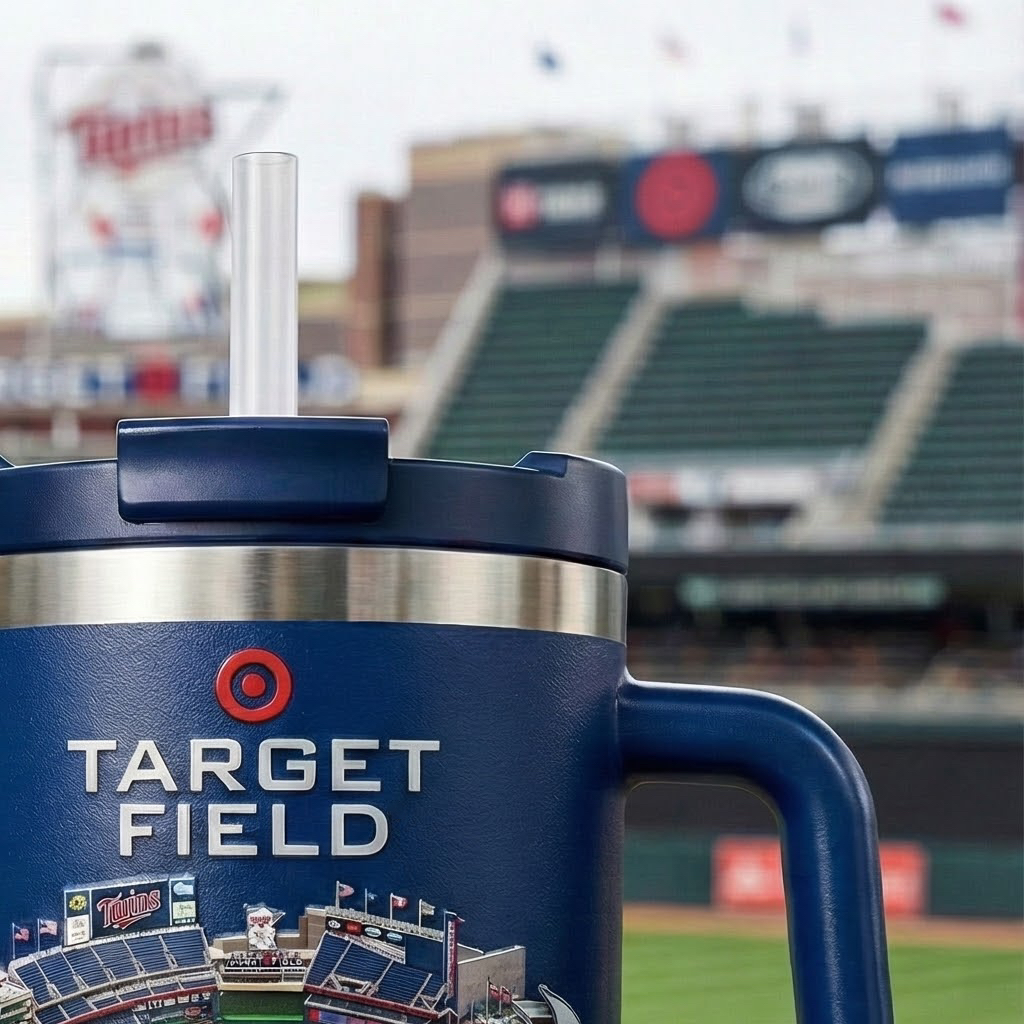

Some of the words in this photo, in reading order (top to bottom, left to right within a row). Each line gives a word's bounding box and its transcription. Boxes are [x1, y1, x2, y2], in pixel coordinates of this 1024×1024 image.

[67, 734, 440, 793] TARGET
[119, 800, 388, 857] FIELD
[96, 888, 162, 930] Twins
